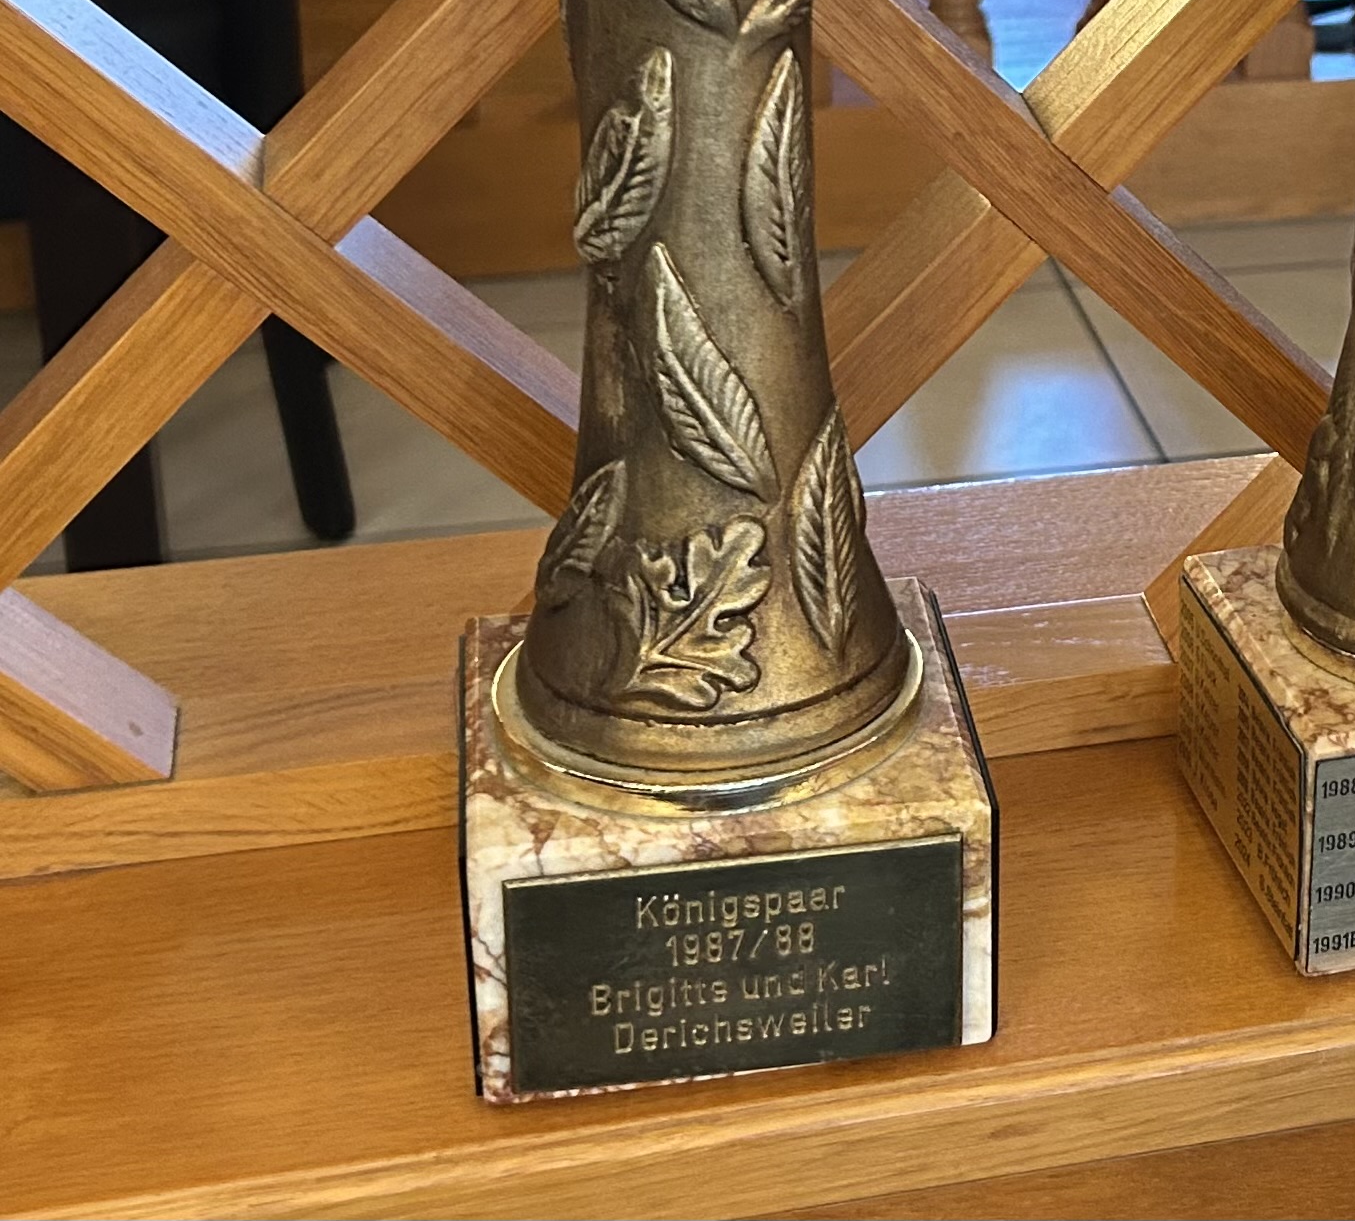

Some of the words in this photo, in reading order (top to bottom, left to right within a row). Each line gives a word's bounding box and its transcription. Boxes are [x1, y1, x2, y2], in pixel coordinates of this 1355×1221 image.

[636, 884, 846, 929] Königspaar
[1315, 881, 1355, 904] 1990
[665, 921, 814, 967] 1987/88
[590, 976, 728, 1017] Brigitte
[741, 962, 805, 999] und
[613, 1000, 872, 1055] Derichsweiler
